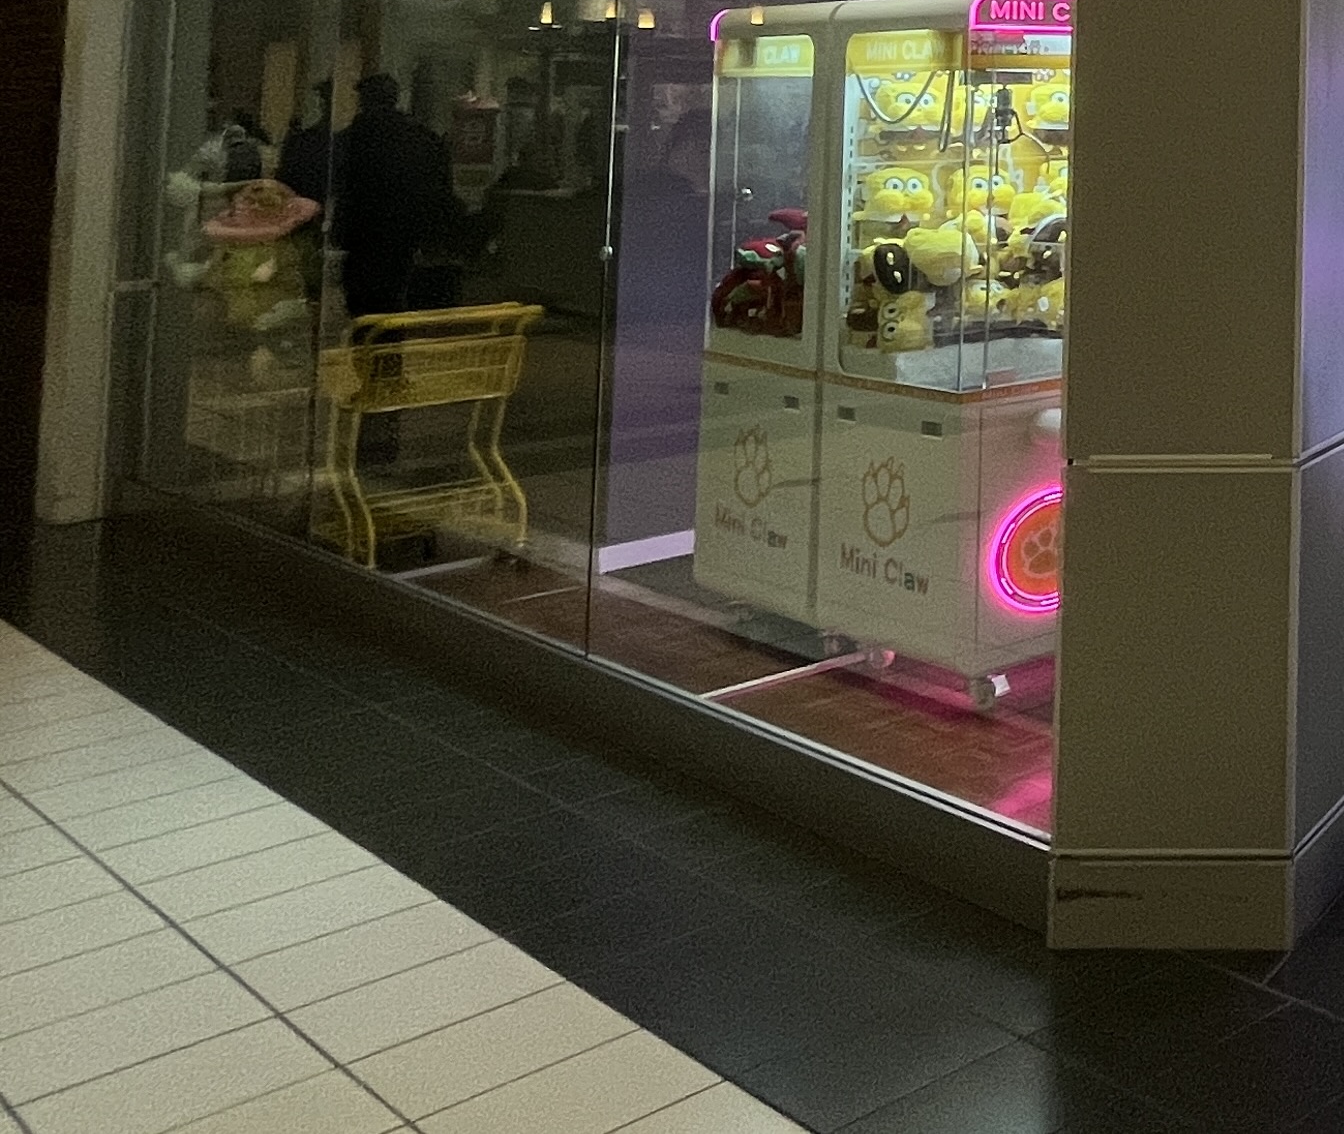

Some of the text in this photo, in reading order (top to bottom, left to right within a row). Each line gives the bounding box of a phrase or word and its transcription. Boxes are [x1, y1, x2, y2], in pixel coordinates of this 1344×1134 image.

[990, 0, 1044, 21] MINI
[764, 44, 798, 64] CLAW
[866, 40, 898, 62] MINI
[751, 517, 788, 550] Claw
[840, 543, 929, 596] Mini Claw
